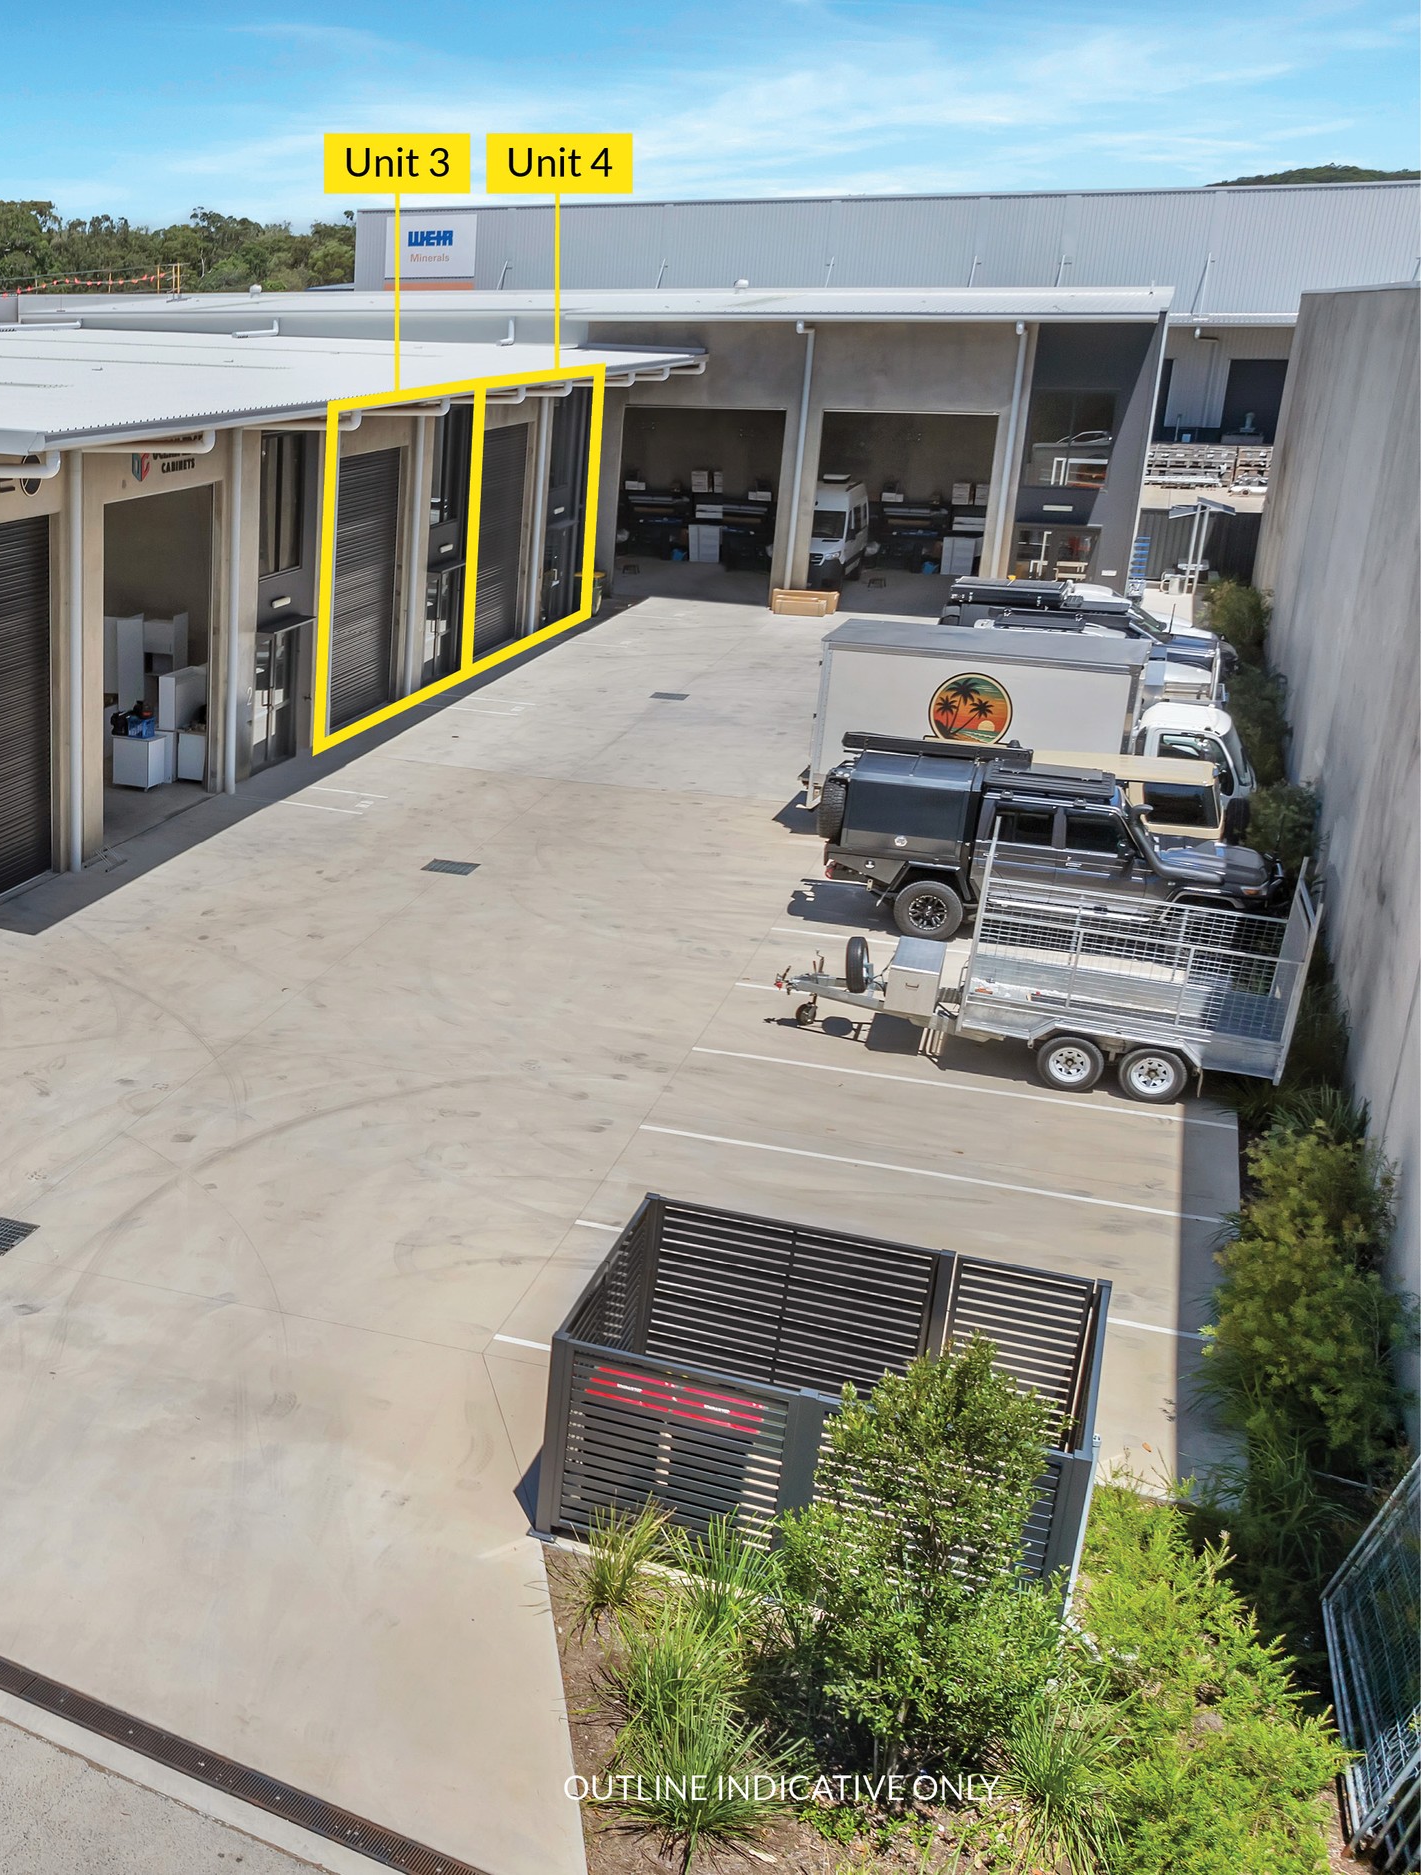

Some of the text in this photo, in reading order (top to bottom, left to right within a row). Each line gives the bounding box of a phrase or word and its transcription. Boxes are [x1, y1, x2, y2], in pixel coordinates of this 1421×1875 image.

[408, 230, 454, 247] WEIR
[410, 253, 450, 263] Minerals
[161, 458, 196, 474] CABINETS
[246, 686, 253, 706] 2
